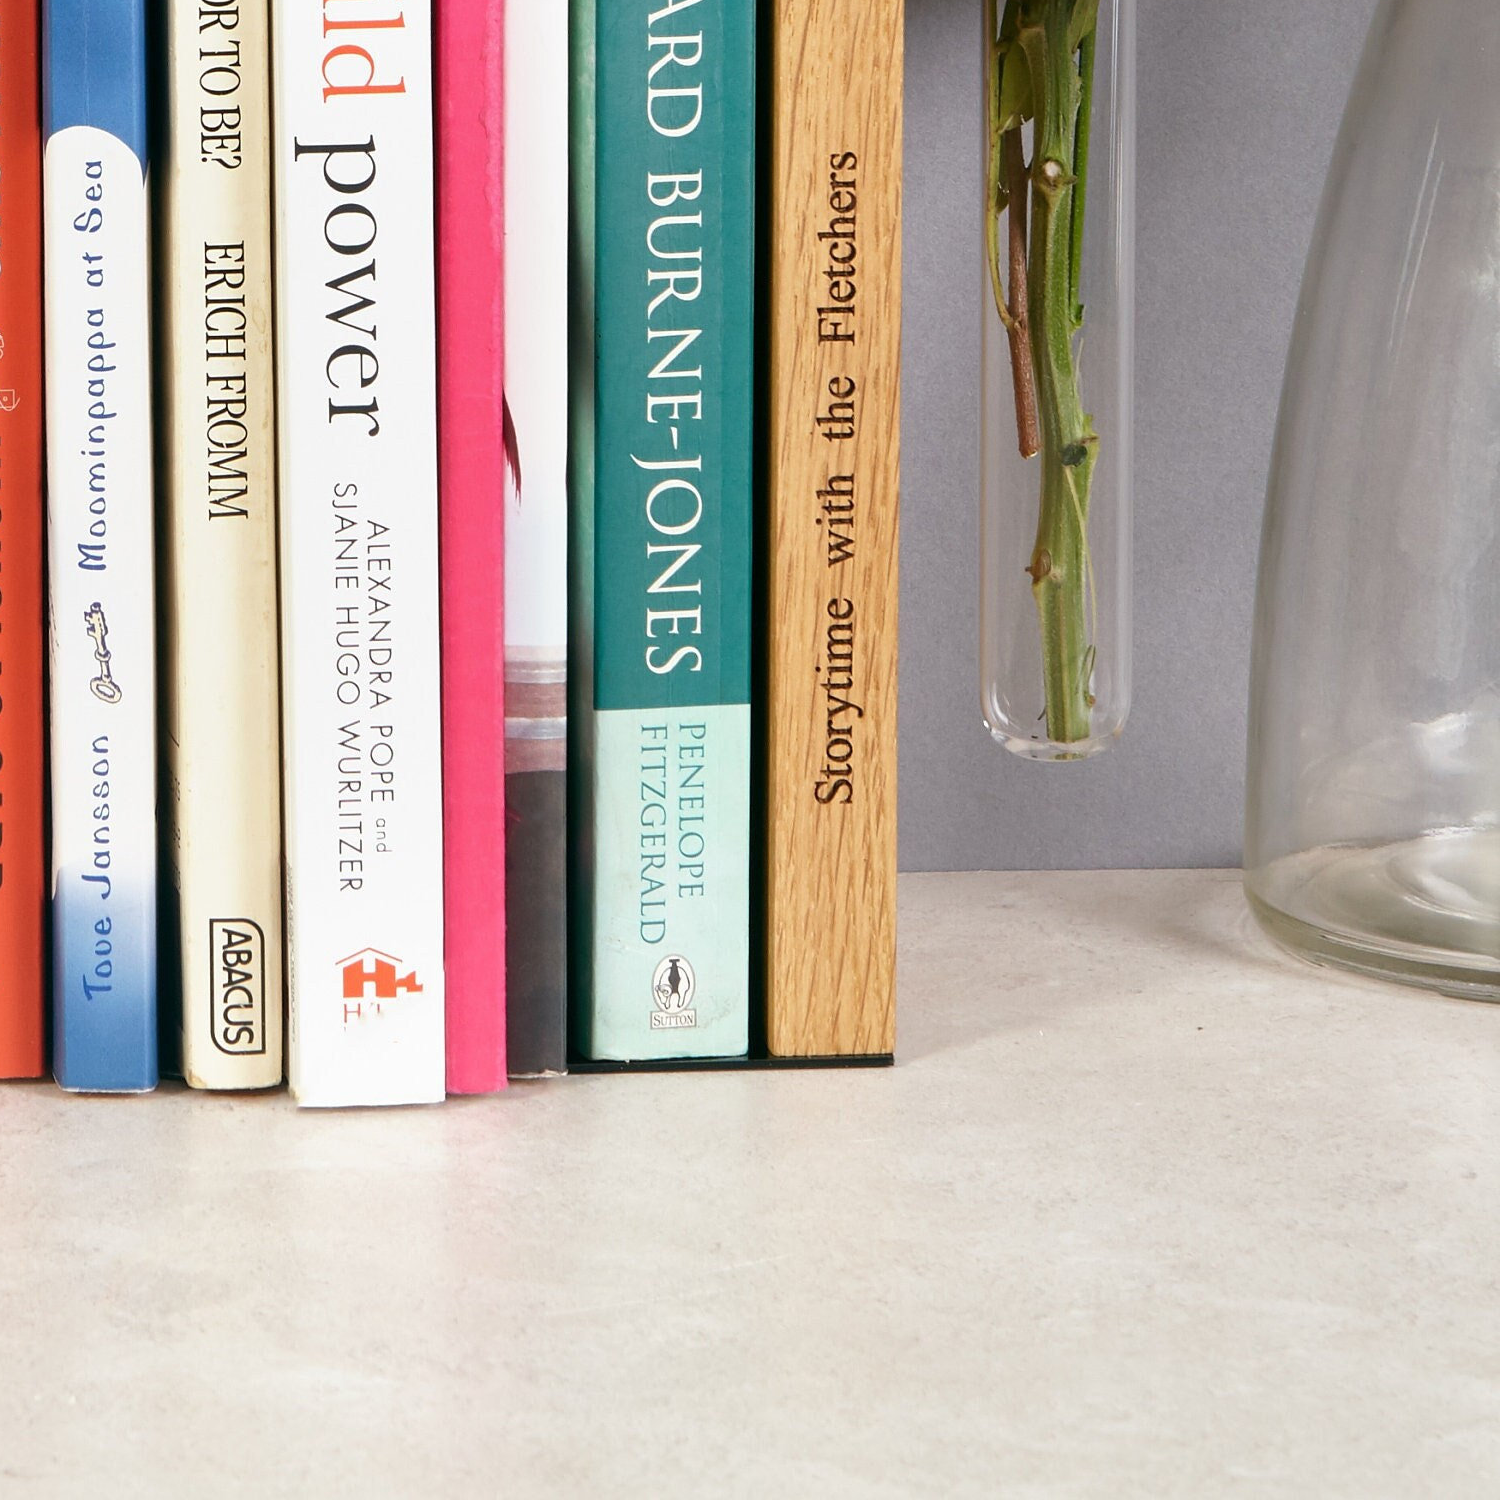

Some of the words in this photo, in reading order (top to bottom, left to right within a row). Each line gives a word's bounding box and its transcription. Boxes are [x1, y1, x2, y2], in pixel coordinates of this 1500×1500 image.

[199, 39, 242, 100] TO
[73, 159, 103, 234] Sea
[200, 104, 243, 171] BE?
[86, 252, 105, 288] at
[204, 240, 247, 362] ERICH
[294, 134, 380, 438] power
[818, 150, 859, 346] Fletchers
[77, 308, 119, 571] Moominpappa
[206, 371, 249, 521] FROMM
[631, 168, 704, 675] BURNE-JONES
[816, 376, 857, 442] the
[332, 482, 359, 590] SJANIE
[815, 473, 856, 567] with
[335, 606, 362, 706] HUGO
[367, 518, 393, 711] ALEXANDRA
[815, 596, 863, 806] Storytime
[82, 735, 111, 899] Jansson
[336, 720, 364, 893] WURLITZER
[369, 725, 395, 803] POPE
[677, 722, 707, 899] PENELOPE
[374, 817, 393, 855] and
[640, 723, 669, 945] FITZGERALD
[84, 916, 113, 1001] Tove
[219, 926, 255, 1046] ABACUS
[652, 1012, 695, 1028] SUTTON
